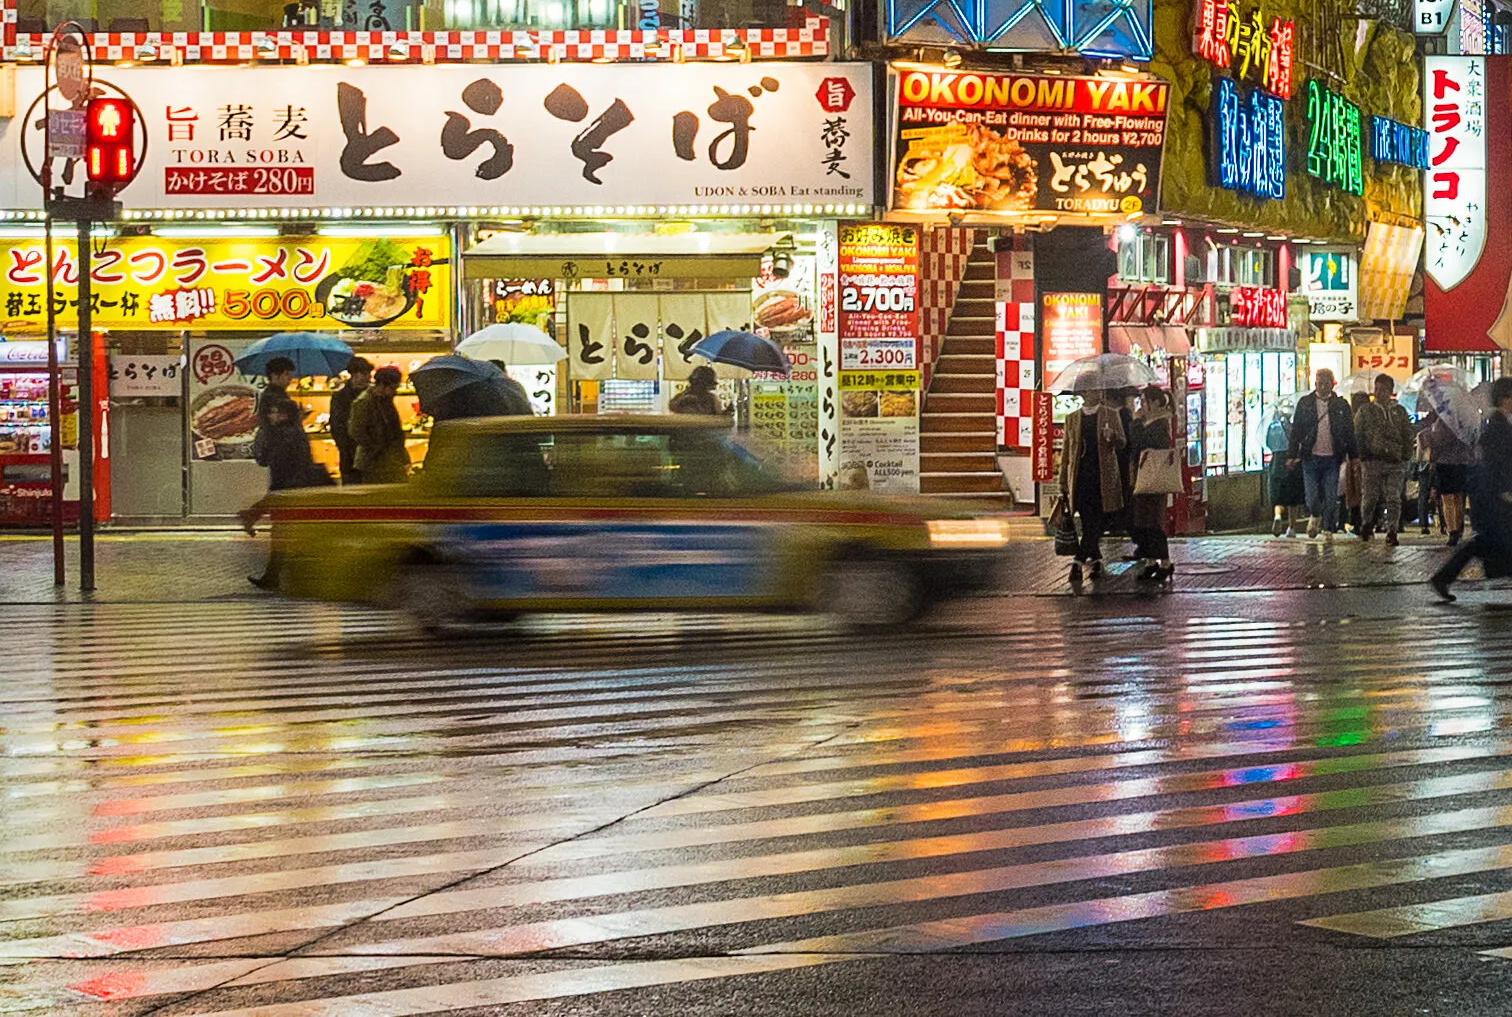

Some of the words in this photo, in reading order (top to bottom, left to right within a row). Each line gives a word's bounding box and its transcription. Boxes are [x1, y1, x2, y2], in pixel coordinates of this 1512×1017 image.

[1420, 12, 1443, 25] B1
[902, 71, 1076, 110] OKONOMI
[1087, 81, 1168, 114] YAKI
[164, 103, 309, 144] 旨蕎麦
[337, 76, 781, 186] とらそば
[902, 106, 1008, 126] All-You-Can-Eat
[1009, 112, 1052, 127] dinner
[1053, 114, 1081, 129] with
[1083, 114, 1164, 133] Free-Flowing
[1007, 127, 1049, 142] Drinks
[1051, 128, 1070, 143] for
[1071, 129, 1081, 144] 2
[1082, 130, 1120, 145] hours
[1122, 132, 1162, 148] ¥2,700
[1432, 69, 1462, 200] トラノコ
[171, 149, 236, 164] TORA
[245, 149, 305, 164] SOBA
[166, 170, 250, 193] かけそば
[252, 168, 315, 194] 280円
[693, 185, 735, 199] UDON
[736, 185, 749, 199] &
[750, 185, 787, 199] SOBA
[789, 185, 811, 199] Eat
[812, 184, 865, 201] standing
[1055, 196, 1121, 211] TORADYU
[7, 246, 329, 286] とんこつラーメン
[606, 260, 663, 276] とらそば
[842, 286, 914, 312] 2,700円
[1043, 293, 1101, 307] OKONOMI
[860, 349, 914, 365] 2,300円
[1356, 354, 1410, 370] トラノコ
[820, 343, 839, 491] とらそば
